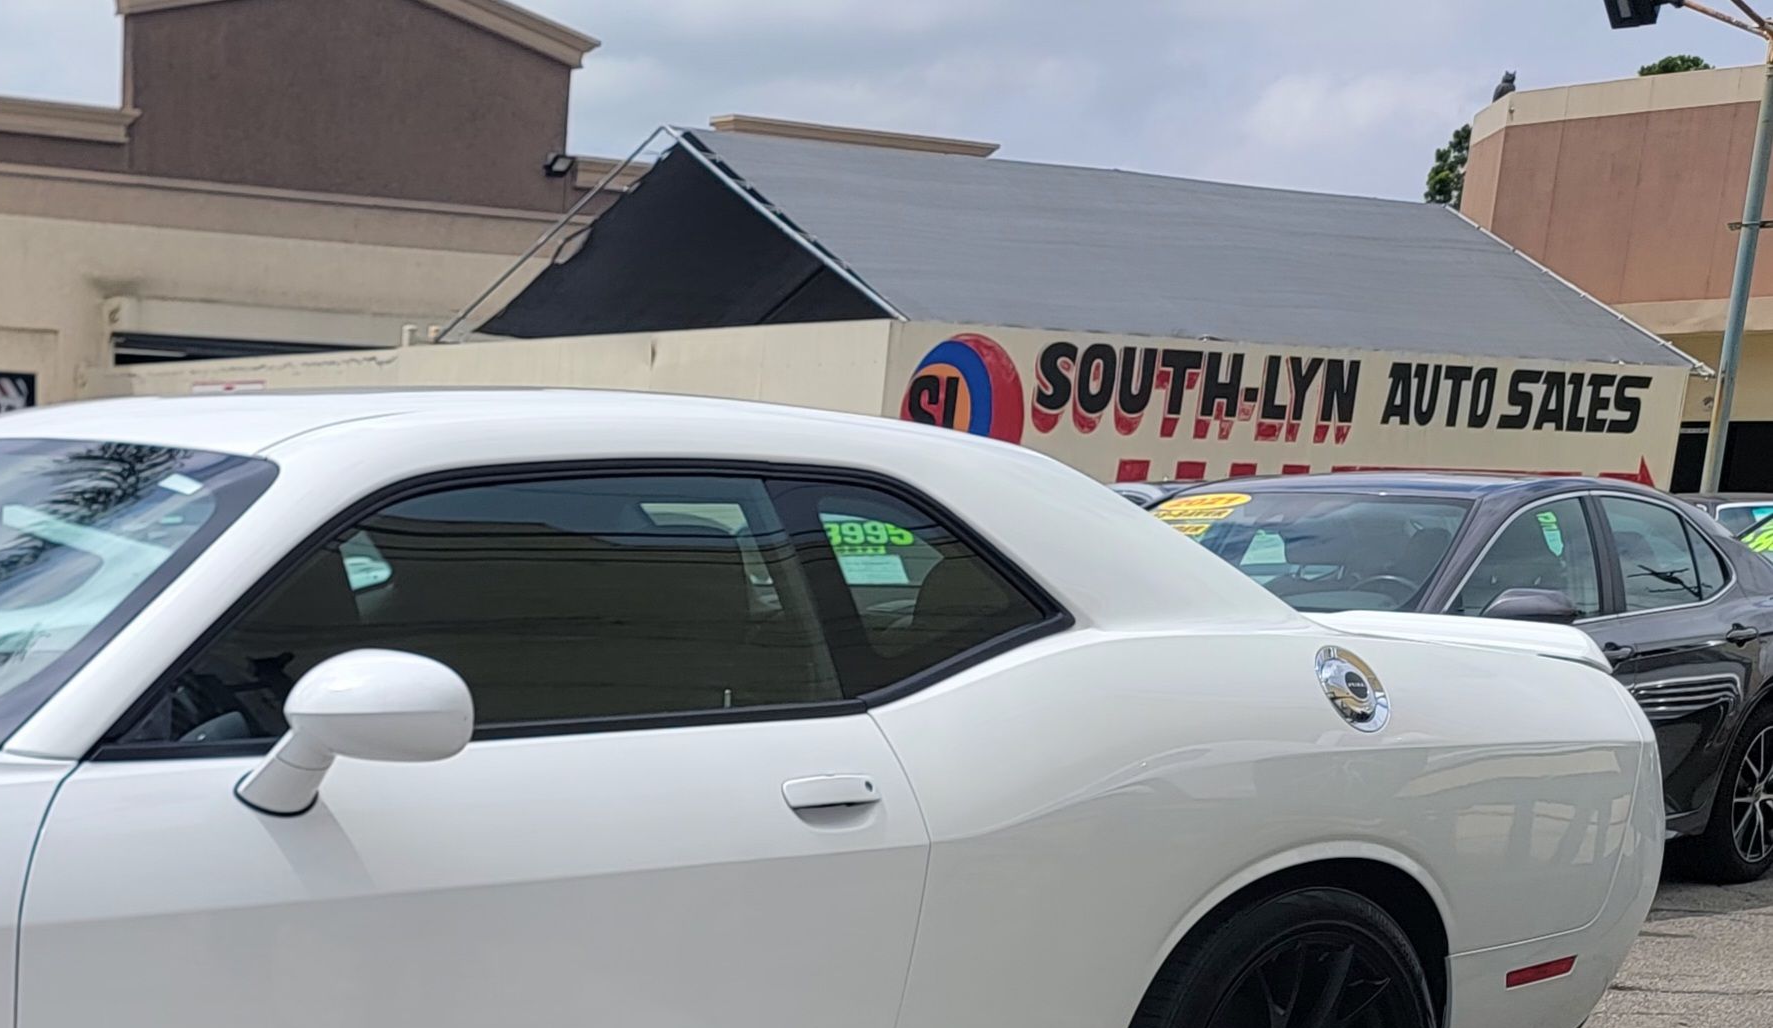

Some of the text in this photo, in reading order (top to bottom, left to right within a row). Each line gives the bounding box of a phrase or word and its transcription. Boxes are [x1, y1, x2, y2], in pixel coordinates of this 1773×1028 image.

[1036, 341, 1653, 434] SOUTH-LYN AUTO SALES
